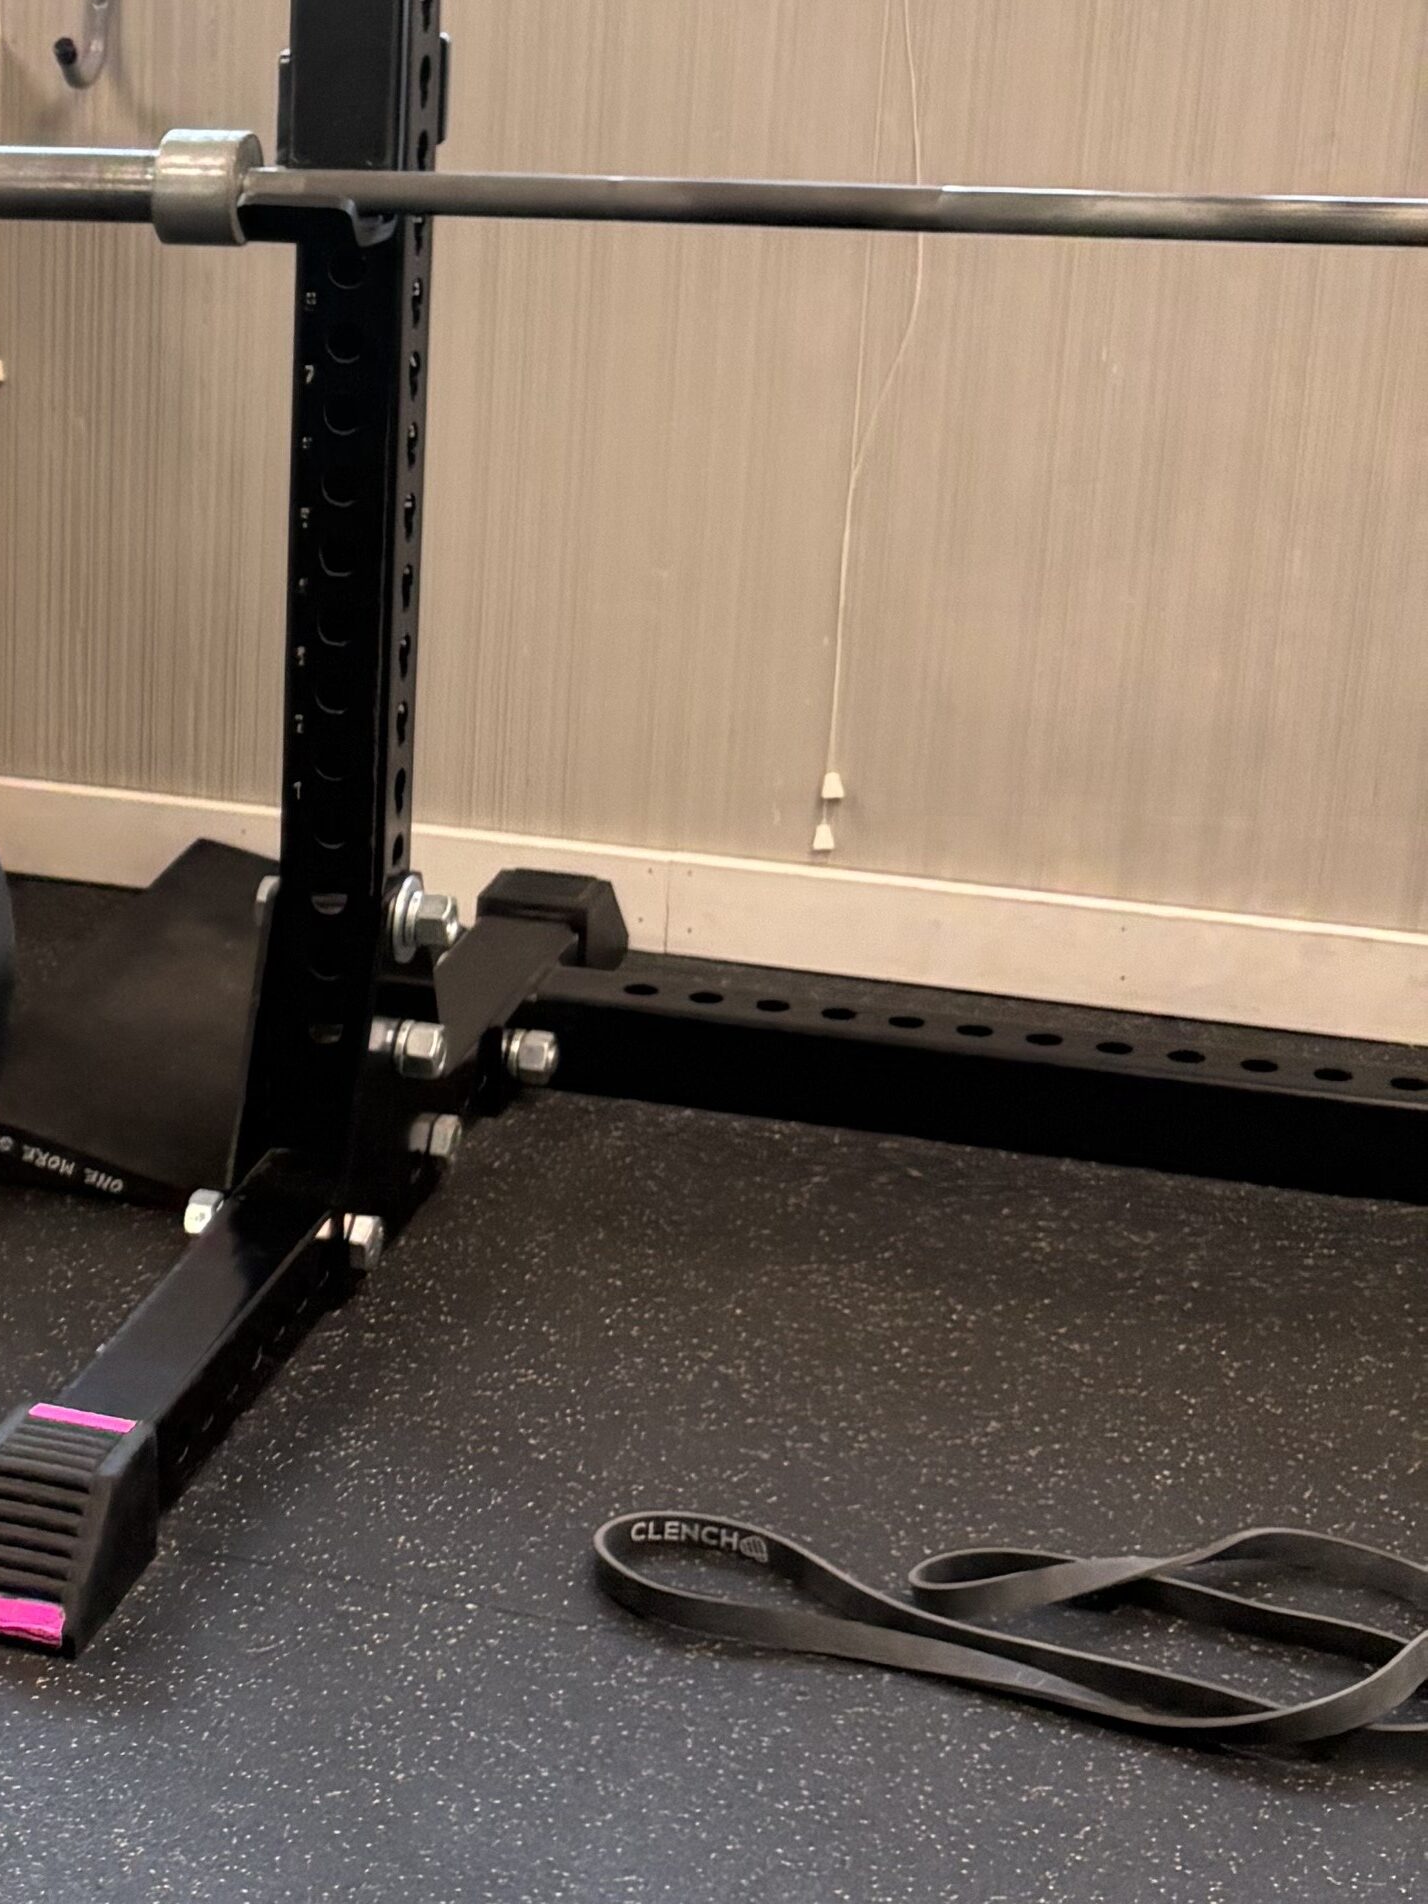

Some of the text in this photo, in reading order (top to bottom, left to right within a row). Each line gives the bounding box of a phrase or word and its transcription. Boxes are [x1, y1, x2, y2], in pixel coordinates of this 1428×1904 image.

[22, 1144, 75, 1177] MORE
[84, 1167, 124, 1193] ONE
[630, 1520, 739, 1551] CLENCH
